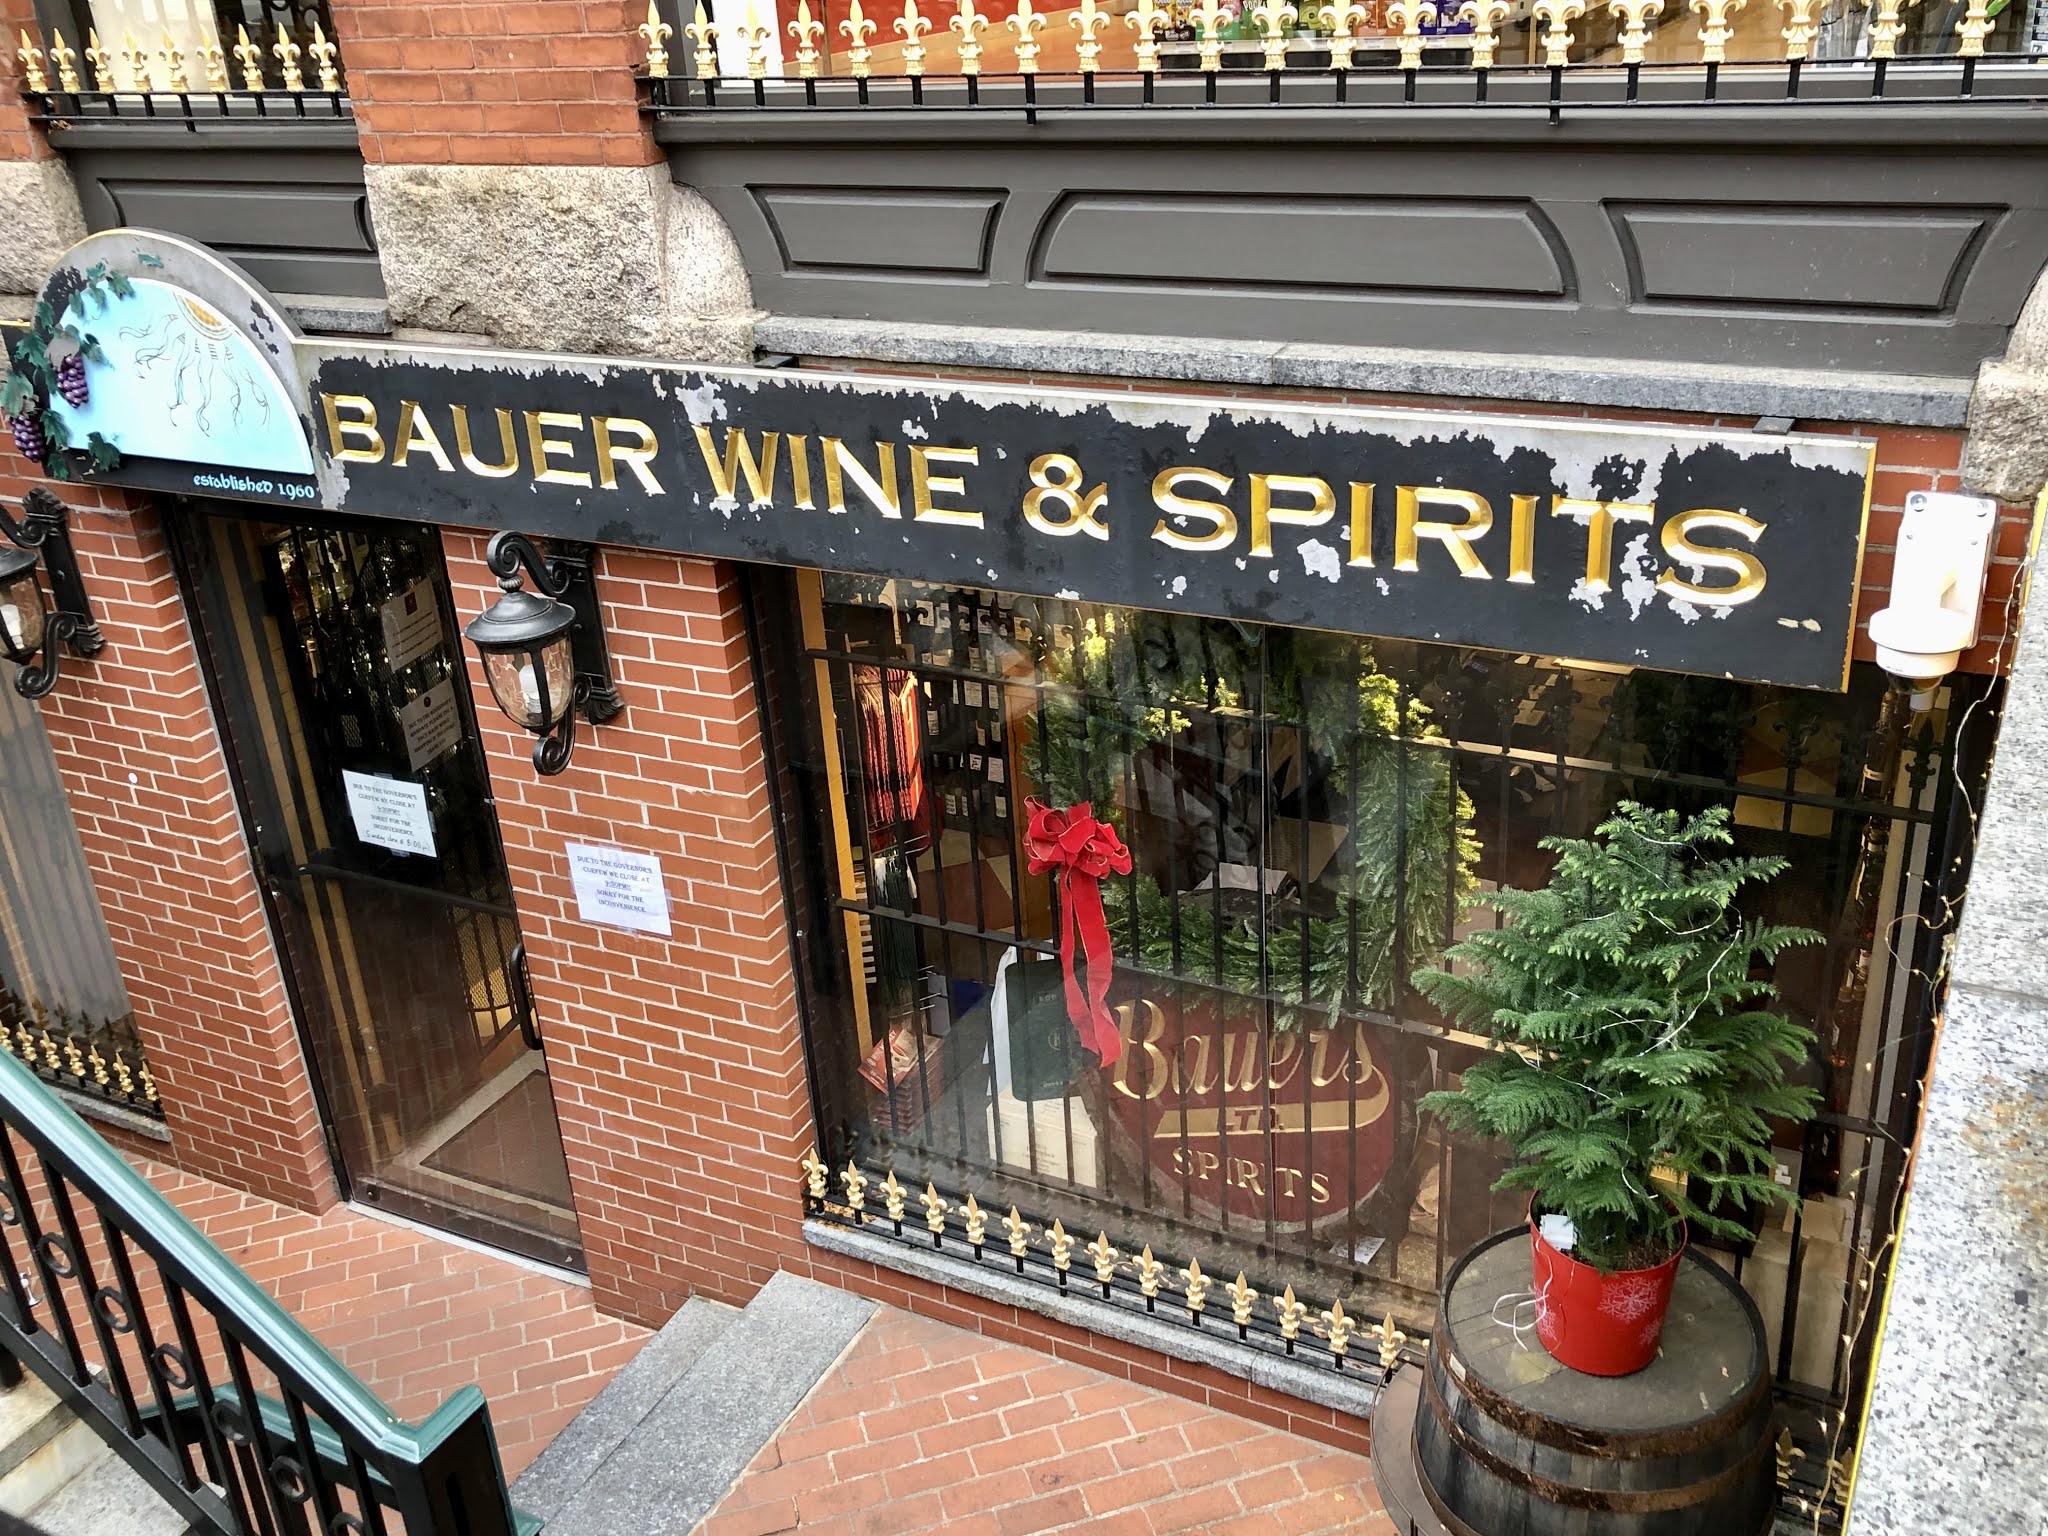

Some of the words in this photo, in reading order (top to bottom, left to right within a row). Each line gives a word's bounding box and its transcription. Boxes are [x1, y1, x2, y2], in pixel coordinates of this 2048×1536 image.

[193, 473, 273, 494] established
[278, 483, 315, 500] 1960
[320, 391, 667, 496] BAUER
[691, 424, 986, 531] WINE
[1021, 453, 1110, 541] &
[1150, 466, 1769, 606] SPIRITS
[577, 855, 592, 863] DUE
[591, 857, 599, 865] TO
[600, 859, 613, 868] THE
[583, 866, 608, 876] CURFEW
[609, 871, 620, 879] WE
[619, 873, 638, 881] CLOSE
[596, 888, 617, 898] SORRY
[618, 892, 630, 901] FOR
[632, 894, 645, 903] THE
[1172, 1147, 1330, 1203] SPIRTS
